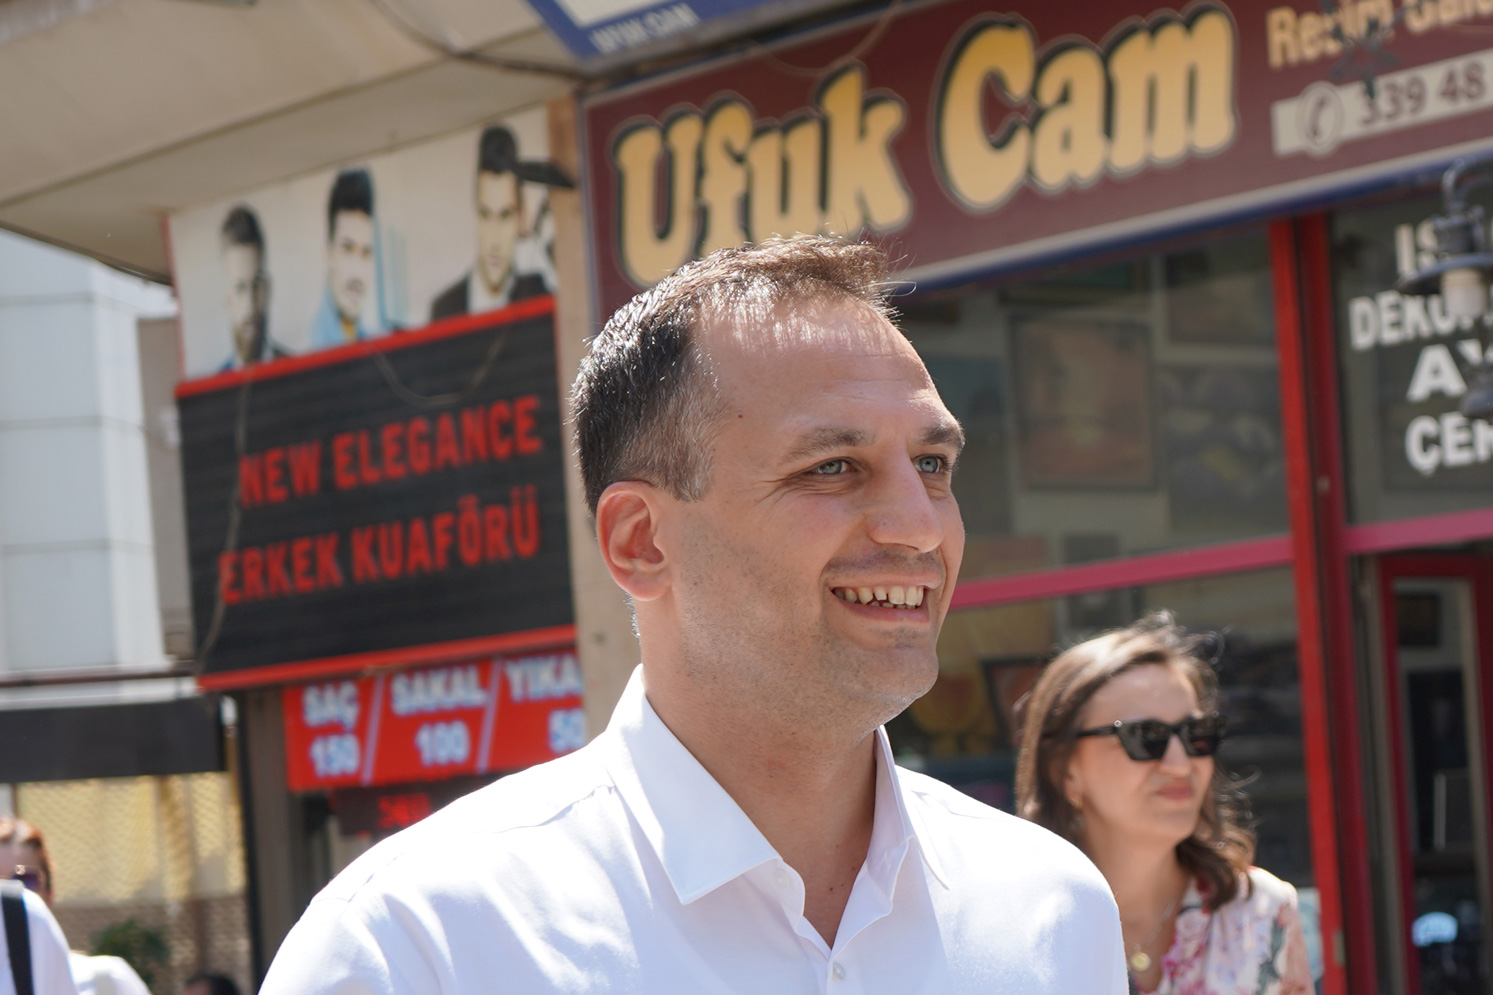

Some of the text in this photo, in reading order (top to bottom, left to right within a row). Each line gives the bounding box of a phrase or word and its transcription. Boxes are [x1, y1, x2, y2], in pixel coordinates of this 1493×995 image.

[1440, 62, 1486, 102] 48
[610, 6, 1237, 288] Ufuk Cam
[239, 394, 543, 509] NEW ELEGANCE
[218, 484, 541, 605] ERKEK KUAFÖRÜ
